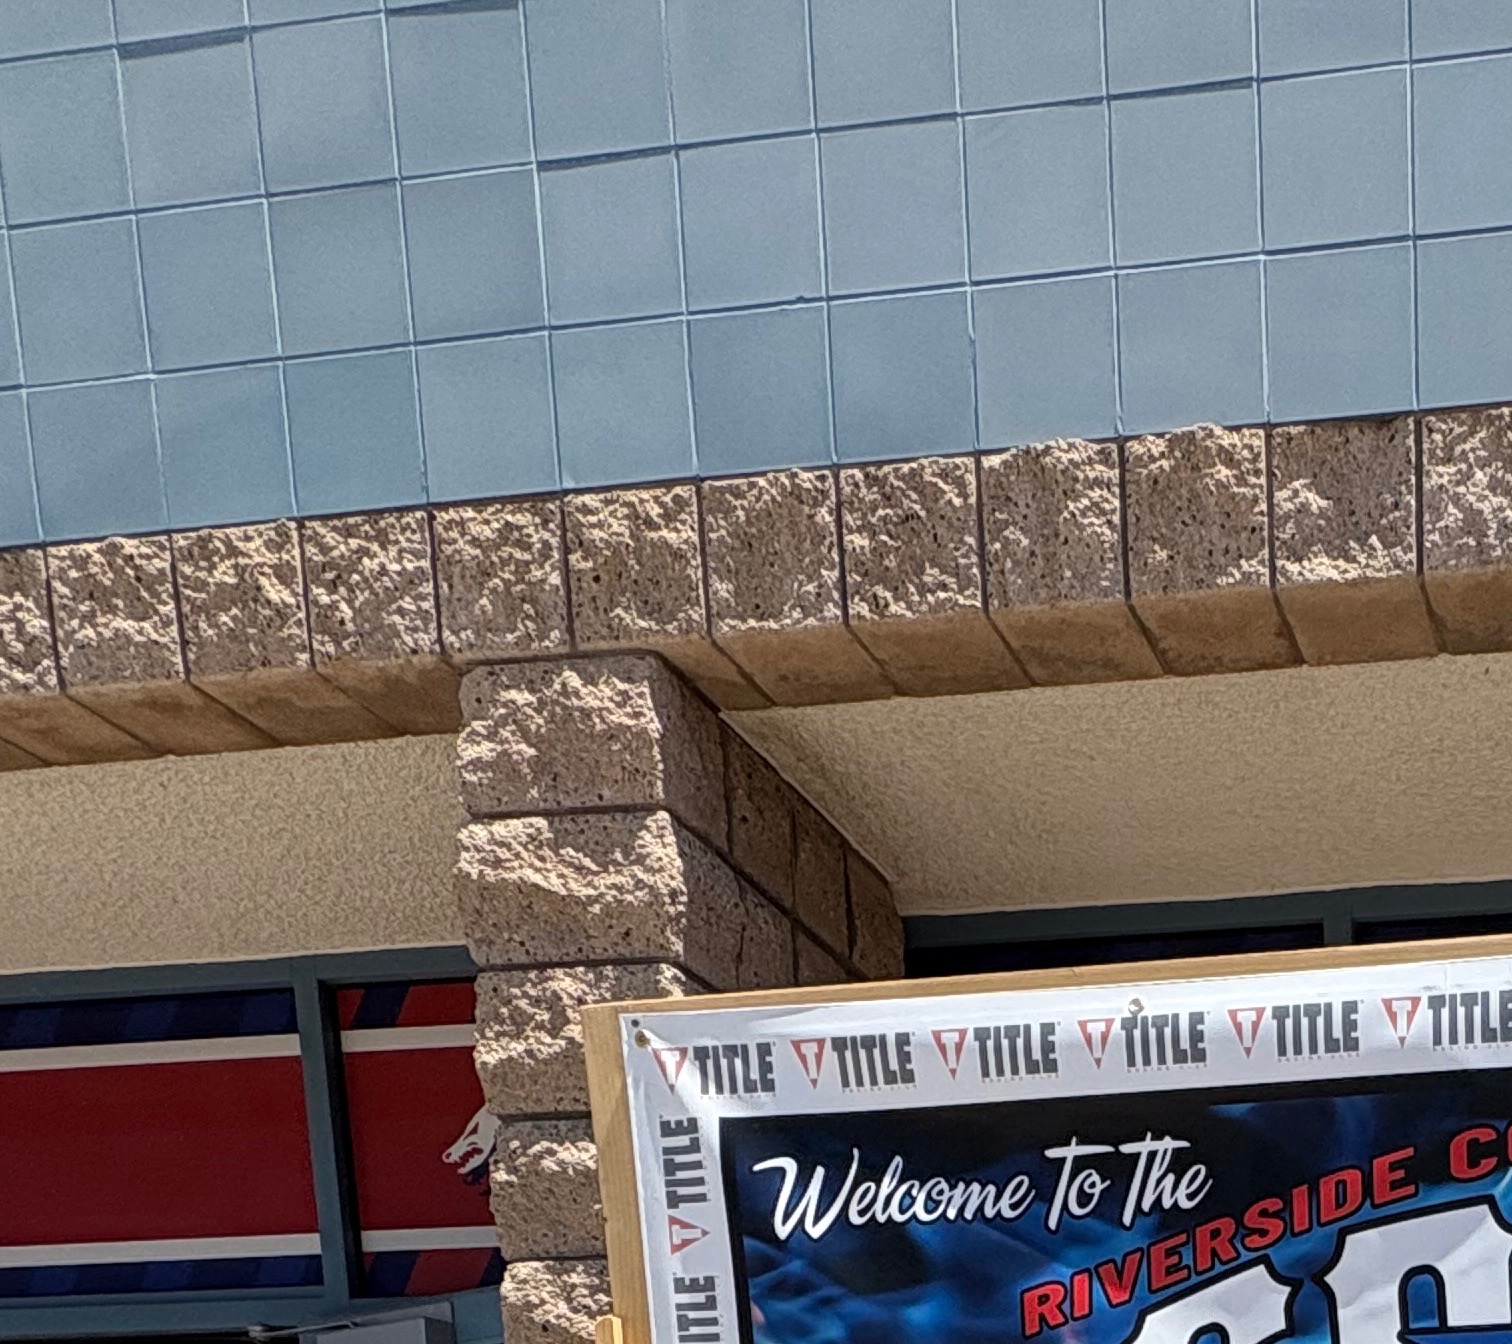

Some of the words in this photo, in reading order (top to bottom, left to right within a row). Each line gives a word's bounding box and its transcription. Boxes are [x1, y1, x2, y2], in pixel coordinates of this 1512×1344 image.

[973, 1022, 1058, 1078] TITLE
[1121, 1011, 1206, 1067] TITLE
[1272, 1000, 1359, 1057] TITLE
[693, 1042, 775, 1095] TITLE
[831, 1032, 915, 1088] TITLE
[660, 1117, 711, 1209] TITLE
[753, 1147, 1034, 1241] Welcome
[1044, 1137, 1113, 1231] To
[1120, 1131, 1213, 1227] The
[1022, 1146, 1416, 1335] RIVERSIDE
